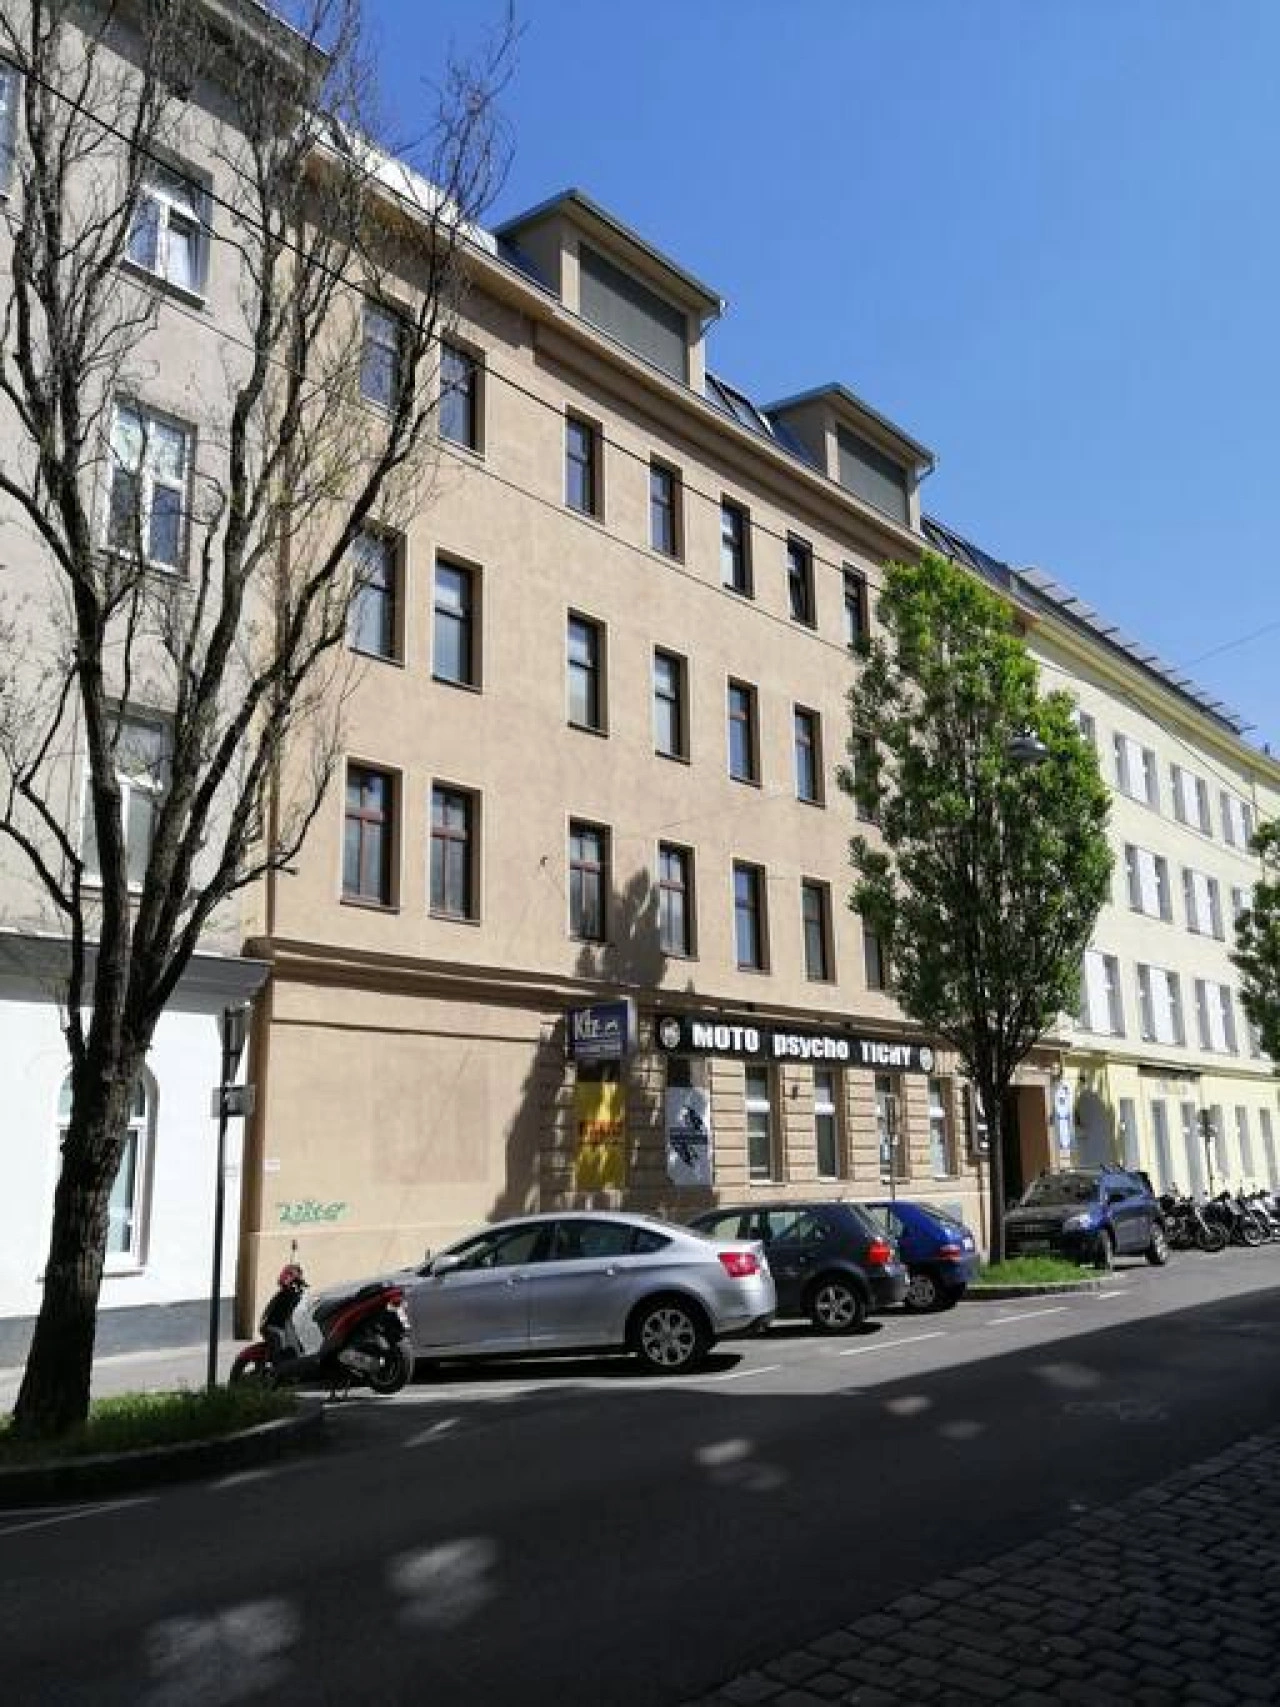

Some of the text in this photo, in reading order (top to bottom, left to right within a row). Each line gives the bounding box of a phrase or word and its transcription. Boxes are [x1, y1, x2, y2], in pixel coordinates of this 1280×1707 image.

[692, 1023, 911, 1066] MOTO psycho TICHY
